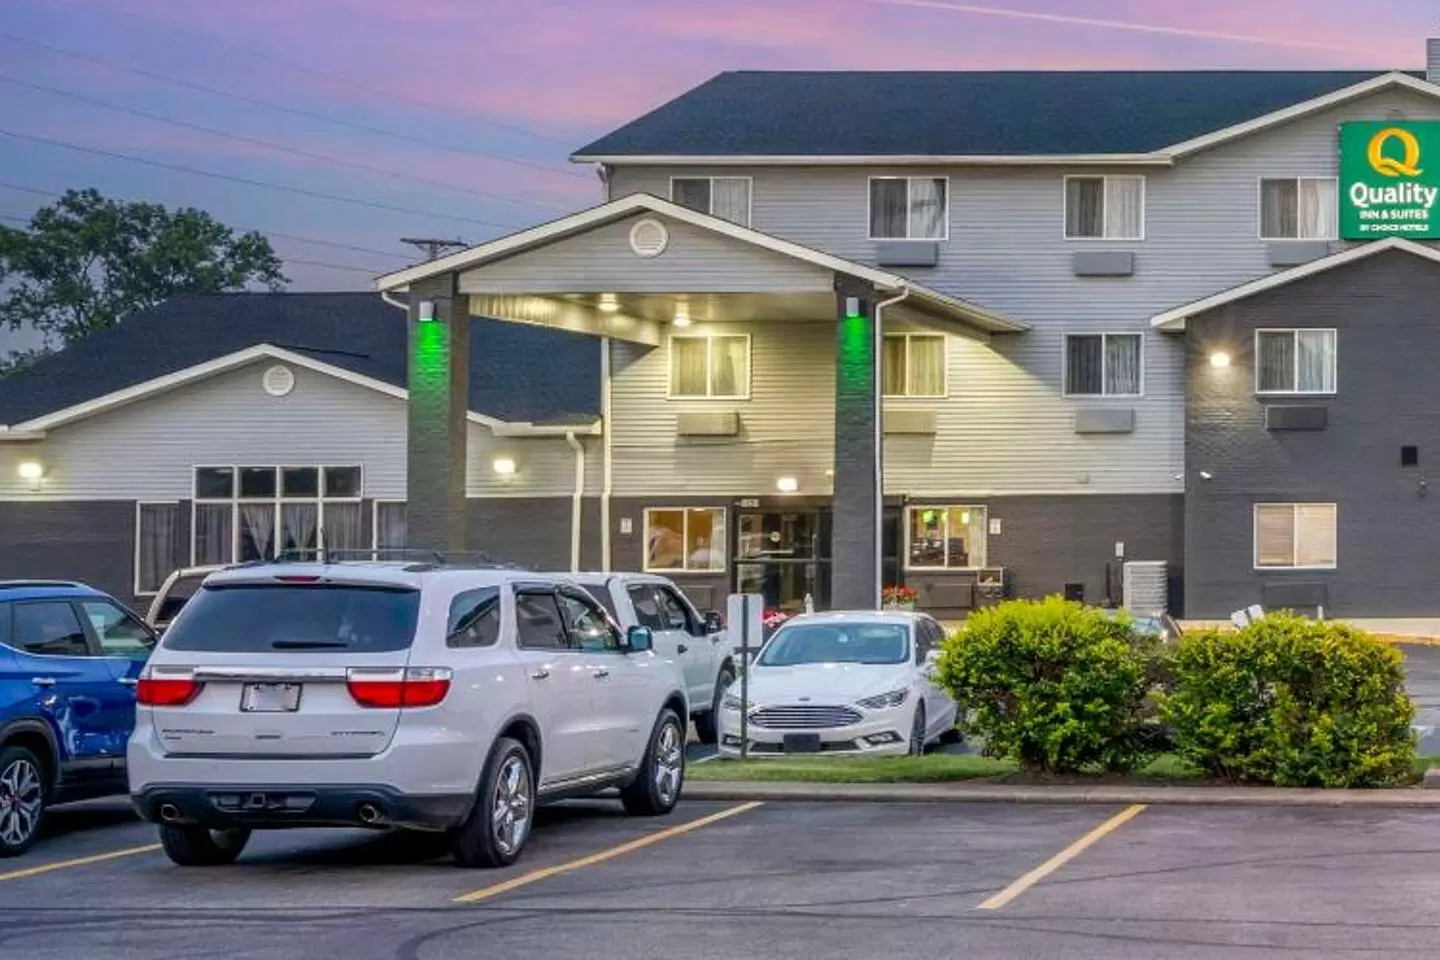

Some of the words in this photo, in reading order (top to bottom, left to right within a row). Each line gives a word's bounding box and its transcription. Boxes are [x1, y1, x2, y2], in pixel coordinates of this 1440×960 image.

[1367, 128, 1423, 177] Q
[1349, 182, 1438, 208] Quality
[1359, 209, 1379, 219] INN
[1390, 209, 1428, 219] SUITES
